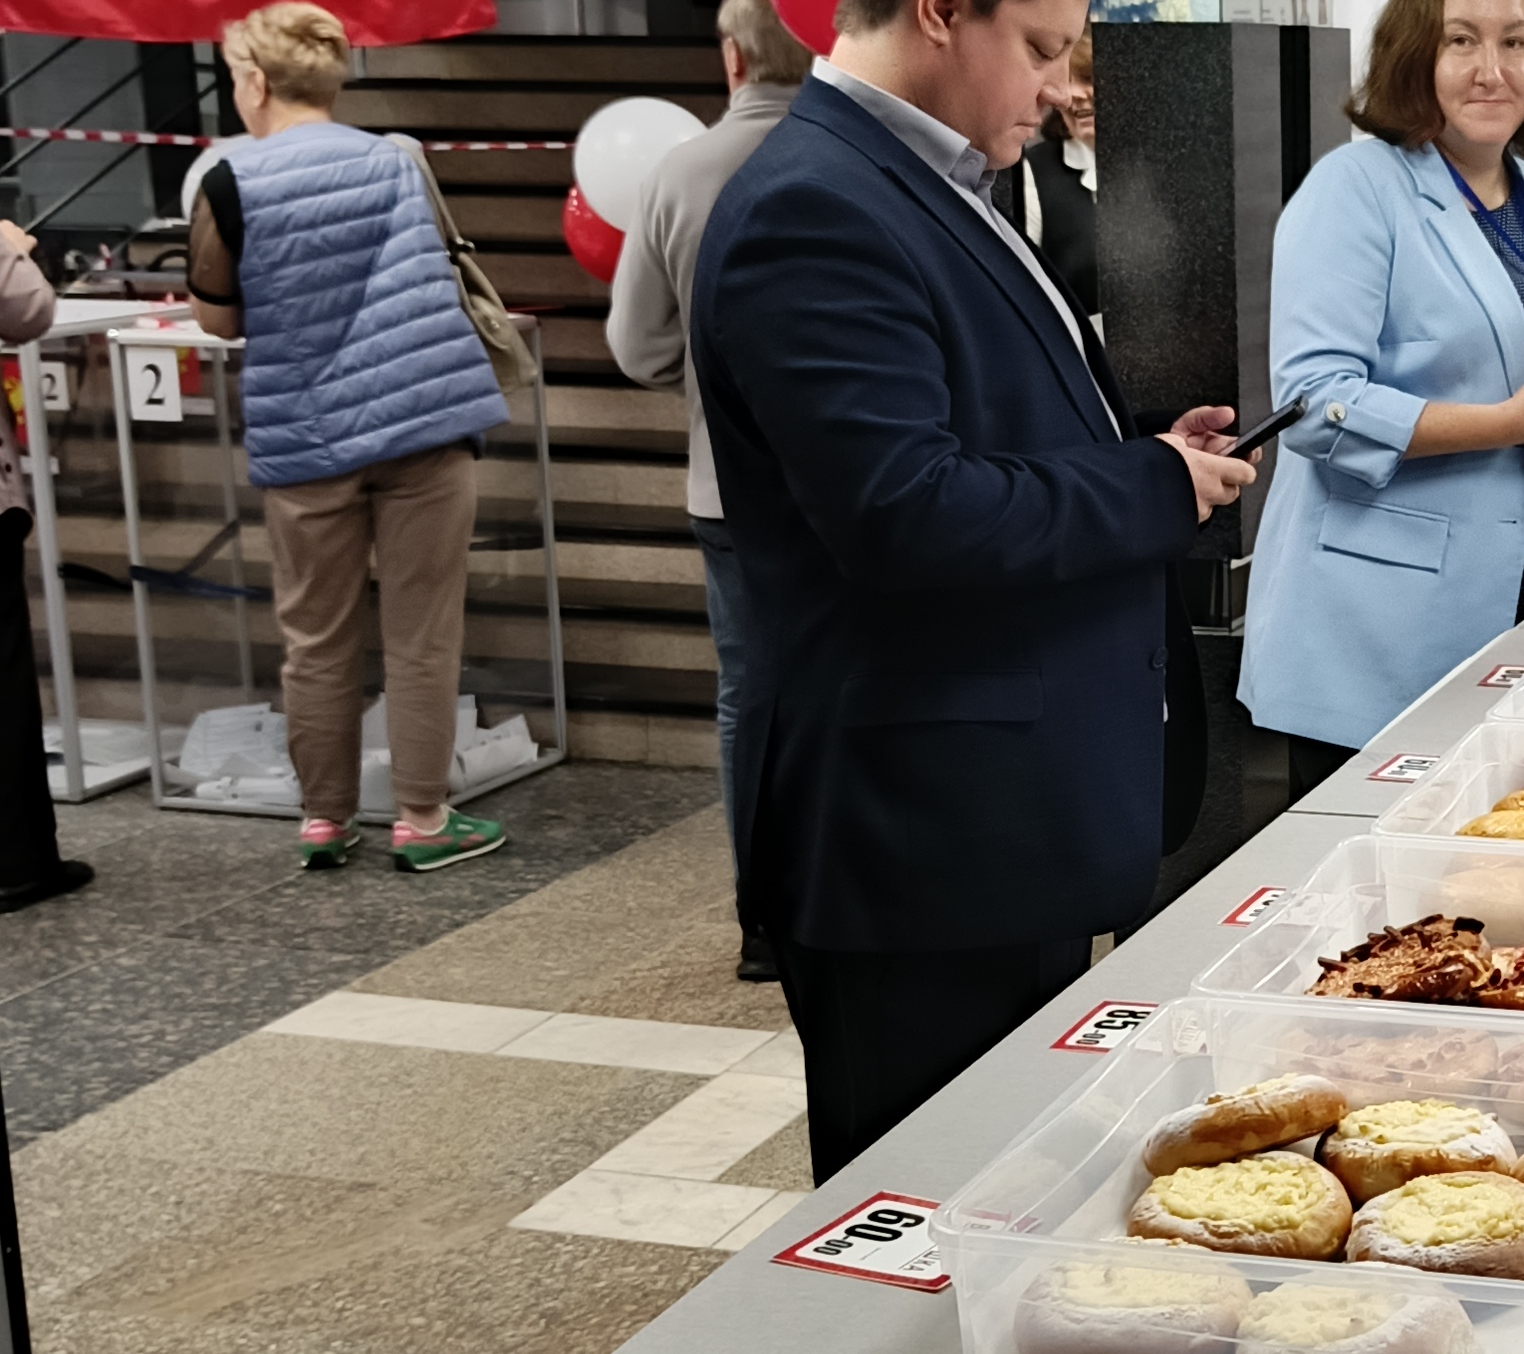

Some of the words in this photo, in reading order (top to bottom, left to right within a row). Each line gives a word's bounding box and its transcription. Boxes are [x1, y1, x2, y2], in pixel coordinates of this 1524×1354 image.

[41, 373, 58, 401] 2
[141, 363, 165, 405] 2
[813, 1208, 925, 1256] 60-00
